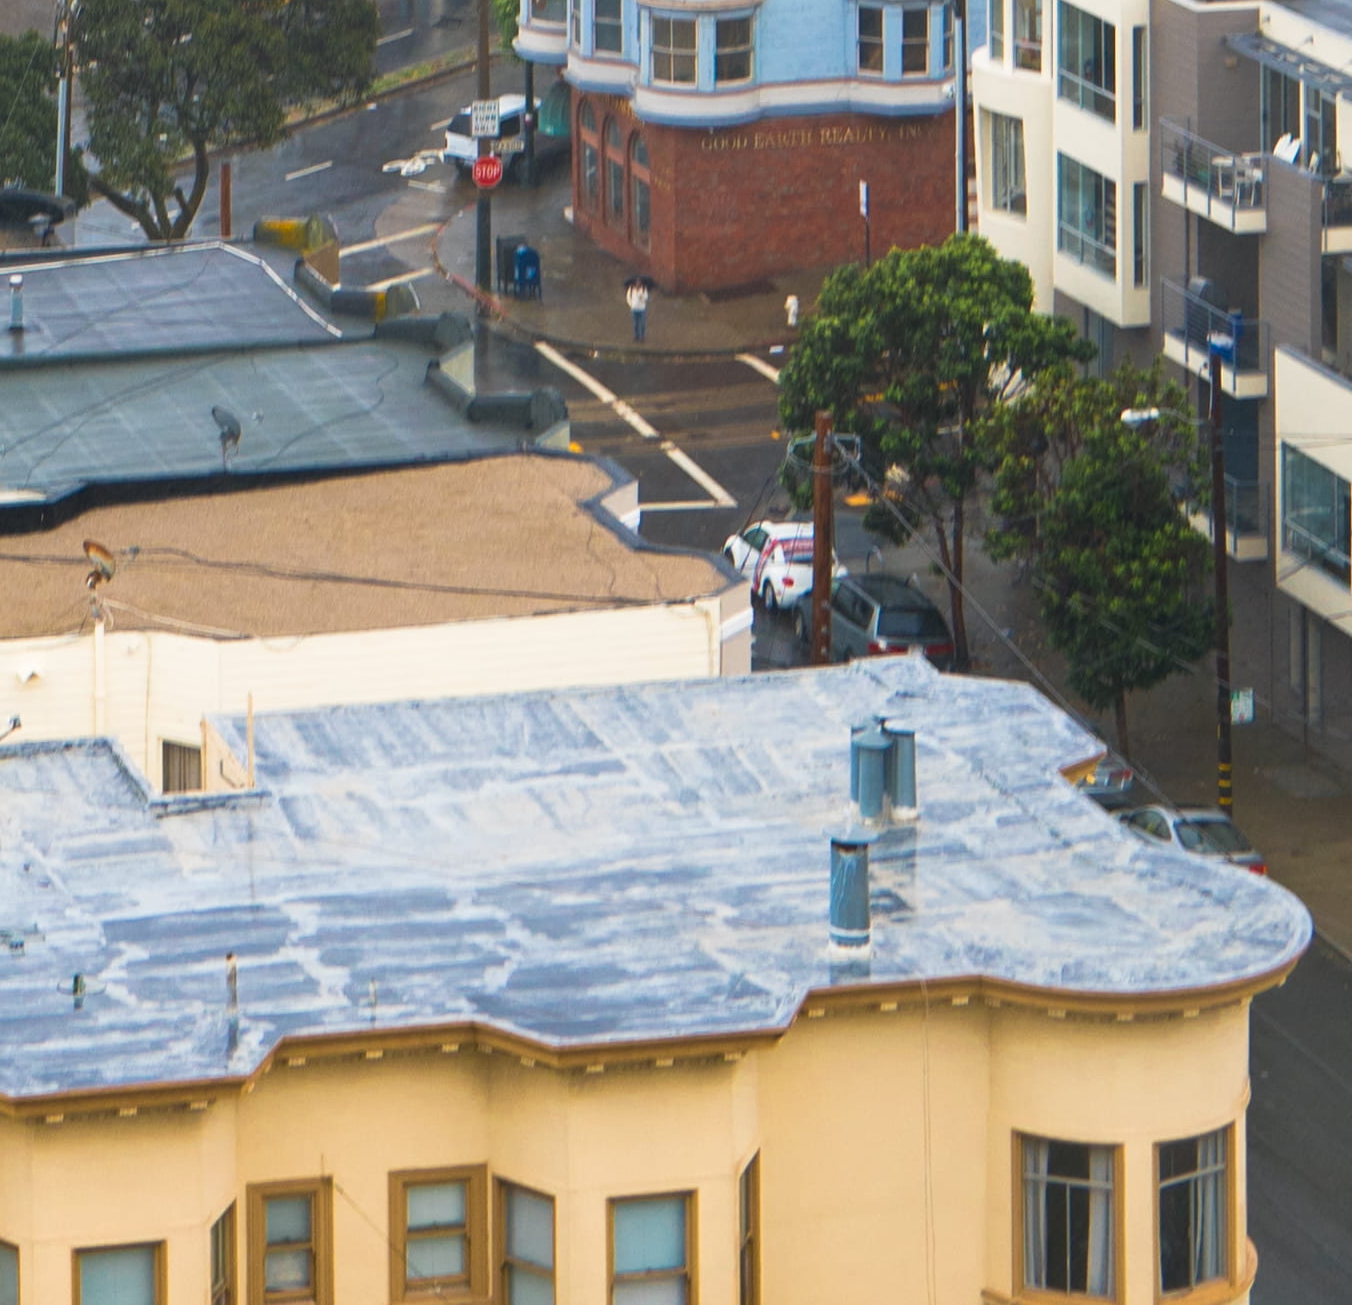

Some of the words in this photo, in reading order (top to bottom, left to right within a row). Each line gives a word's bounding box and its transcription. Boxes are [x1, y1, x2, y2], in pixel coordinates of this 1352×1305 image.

[475, 114, 497, 122] TURN
[701, 138, 747, 151] GOOD
[754, 130, 813, 149] EARTH
[475, 165, 501, 180] STOP
